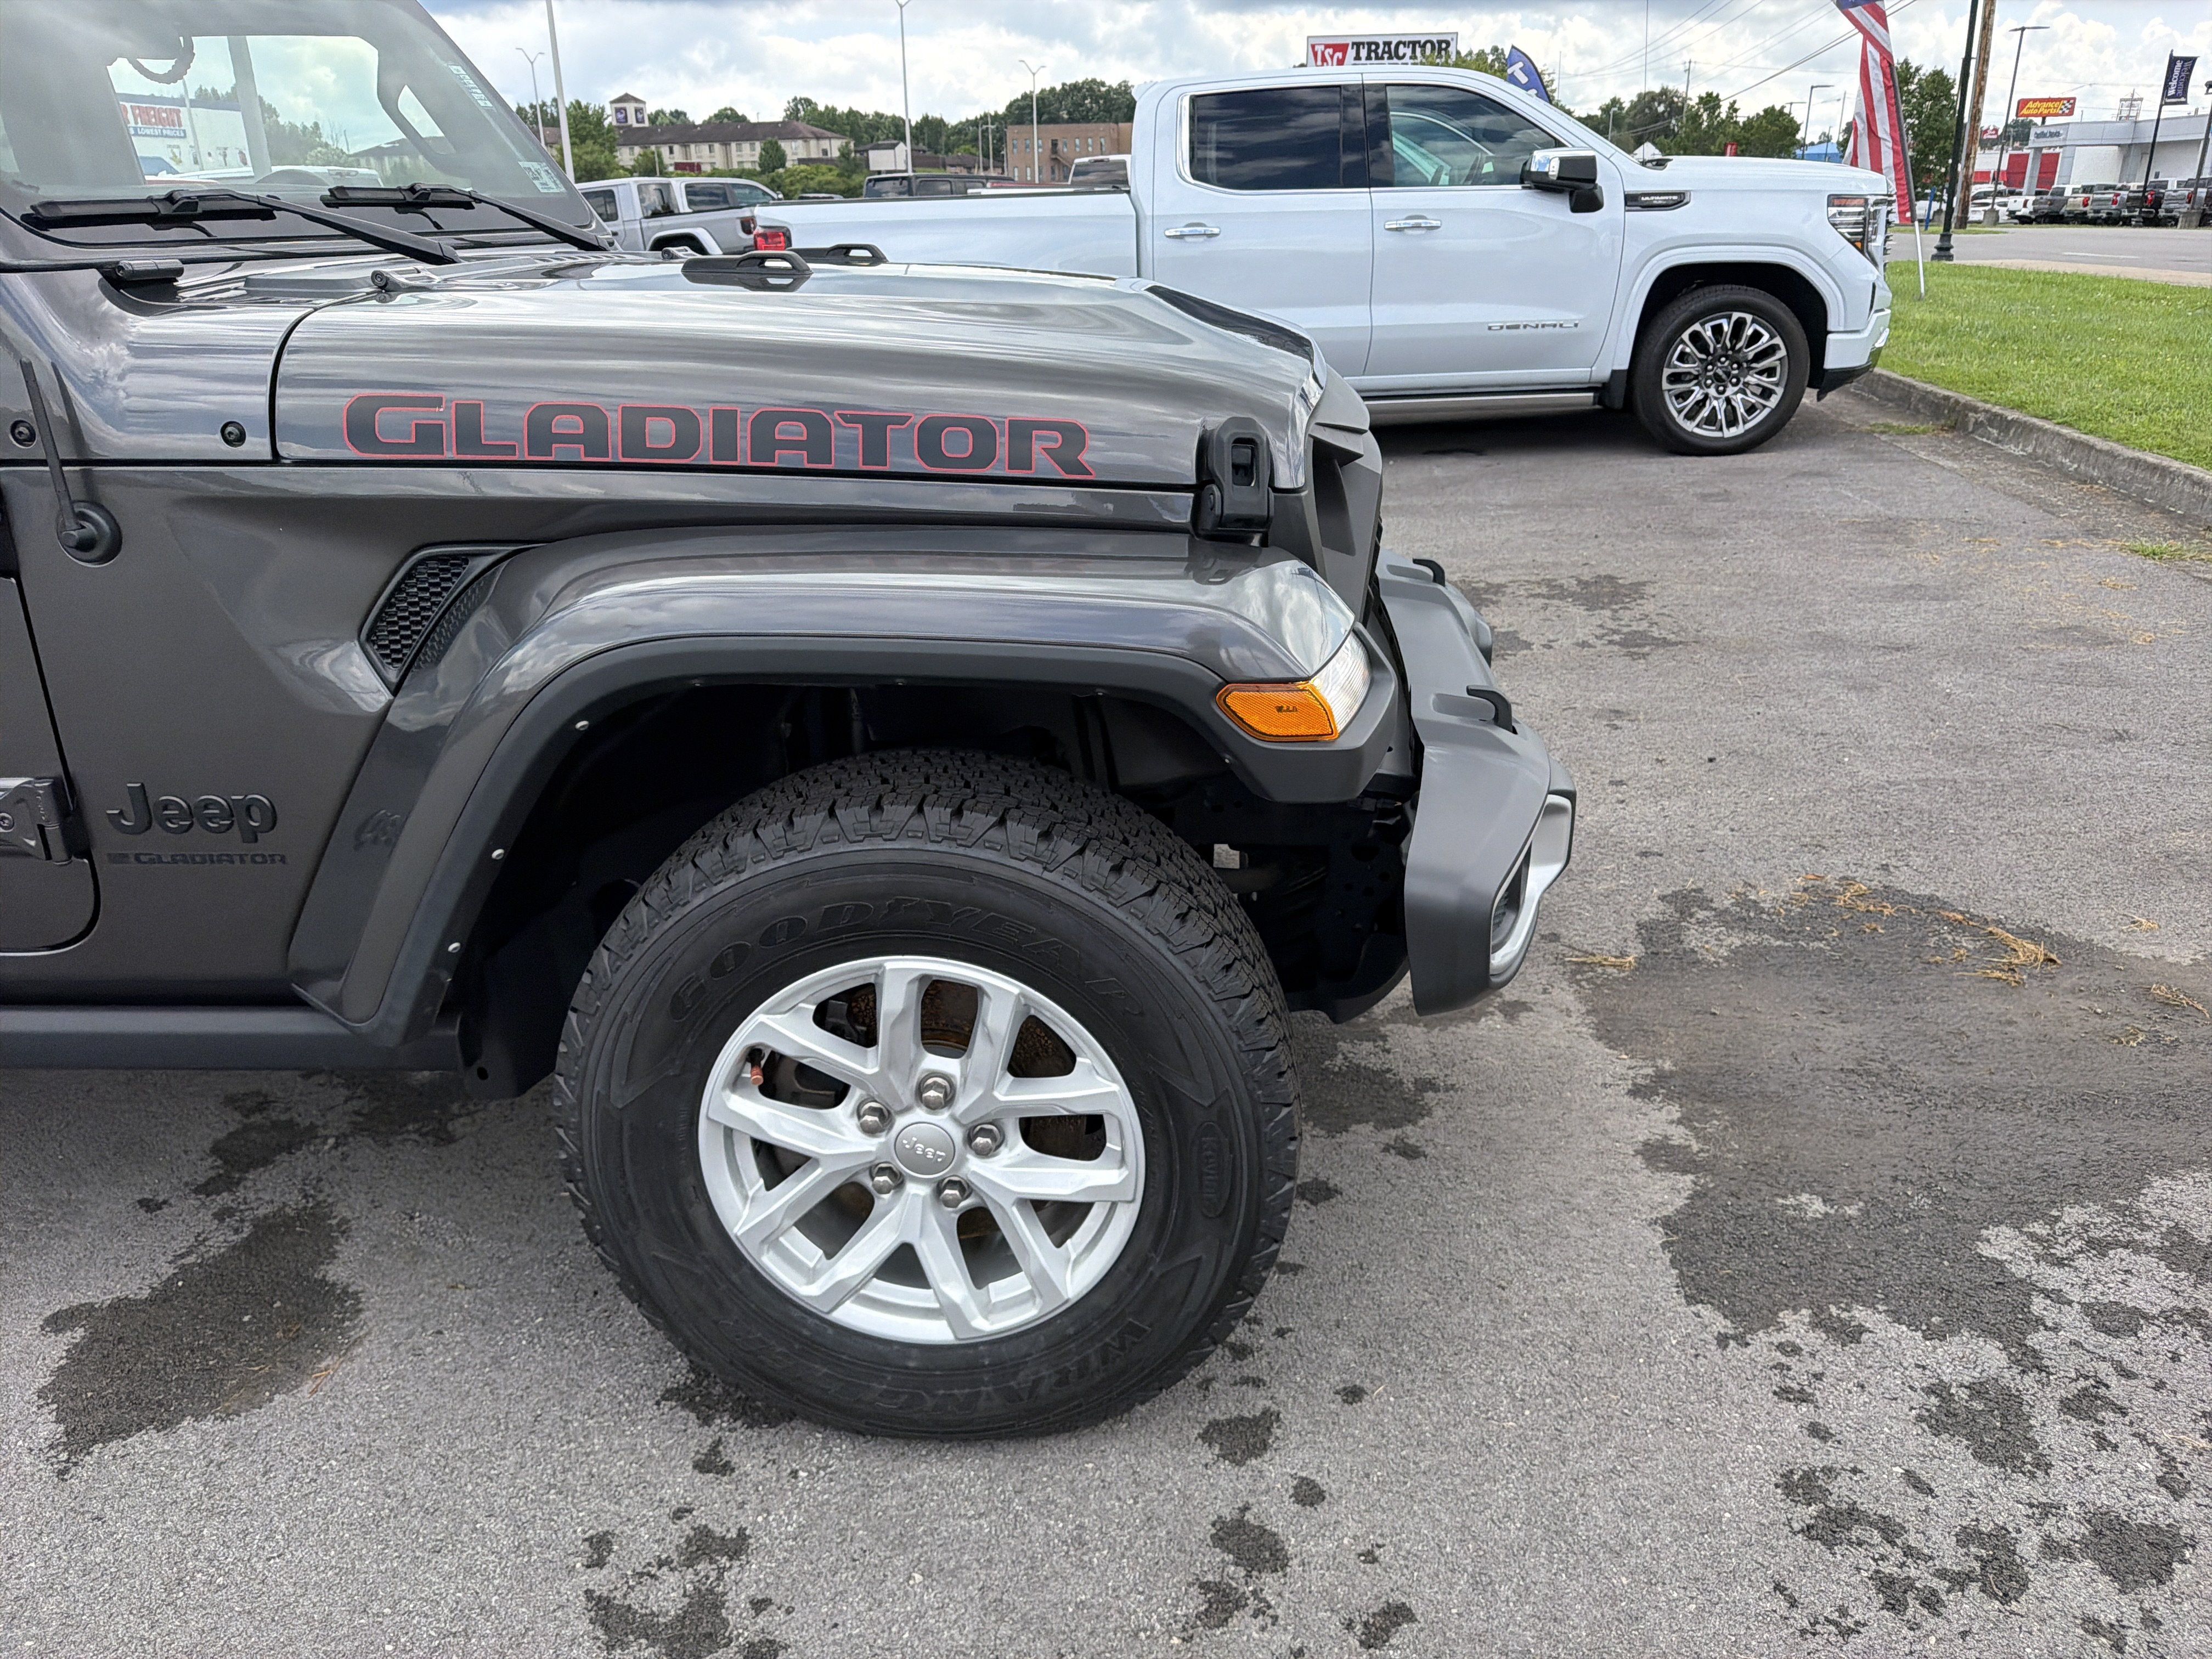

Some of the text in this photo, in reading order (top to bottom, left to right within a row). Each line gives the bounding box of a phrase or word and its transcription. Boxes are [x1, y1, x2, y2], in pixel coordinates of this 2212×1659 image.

[1314, 45, 1343, 66] TSC
[1351, 40, 1452, 62] TRACTOR
[2168, 60, 2183, 96] Welcome
[2176, 60, 2193, 97] Welcome
[130, 105, 183, 127] FREIGHT
[2027, 100, 2060, 109] Advance
[1487, 320, 1578, 331] DENALI
[343, 393, 1096, 477] GLADIATOR
[106, 782, 278, 843] Jeep
[134, 853, 287, 865] GLADIATOR
[669, 895, 1146, 1023] GOODYEAR
[902, 1136, 946, 1163] Jeep
